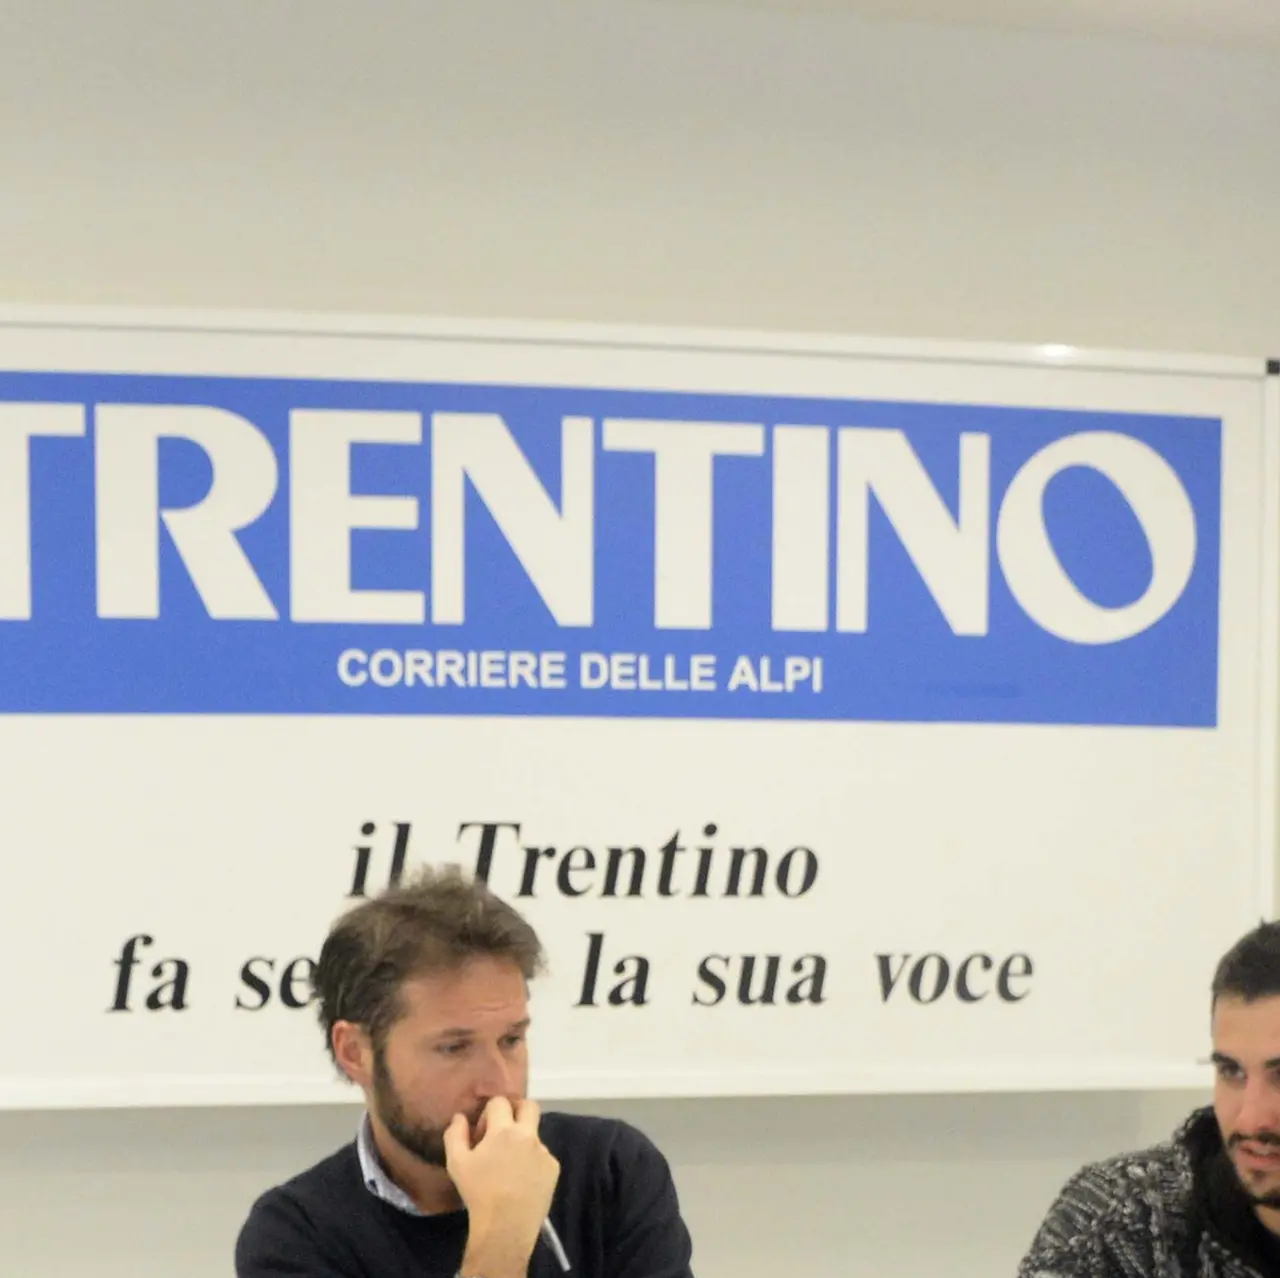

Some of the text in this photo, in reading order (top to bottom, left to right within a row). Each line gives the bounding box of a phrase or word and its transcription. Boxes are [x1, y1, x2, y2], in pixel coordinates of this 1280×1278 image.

[336, 649, 824, 694] CORRIERE DELLE ALPI
[348, 821, 820, 900] il Trentino
[110, 934, 191, 1013] fa
[576, 931, 651, 1008] la
[692, 954, 829, 1007] sua
[876, 952, 1034, 1004] voce
